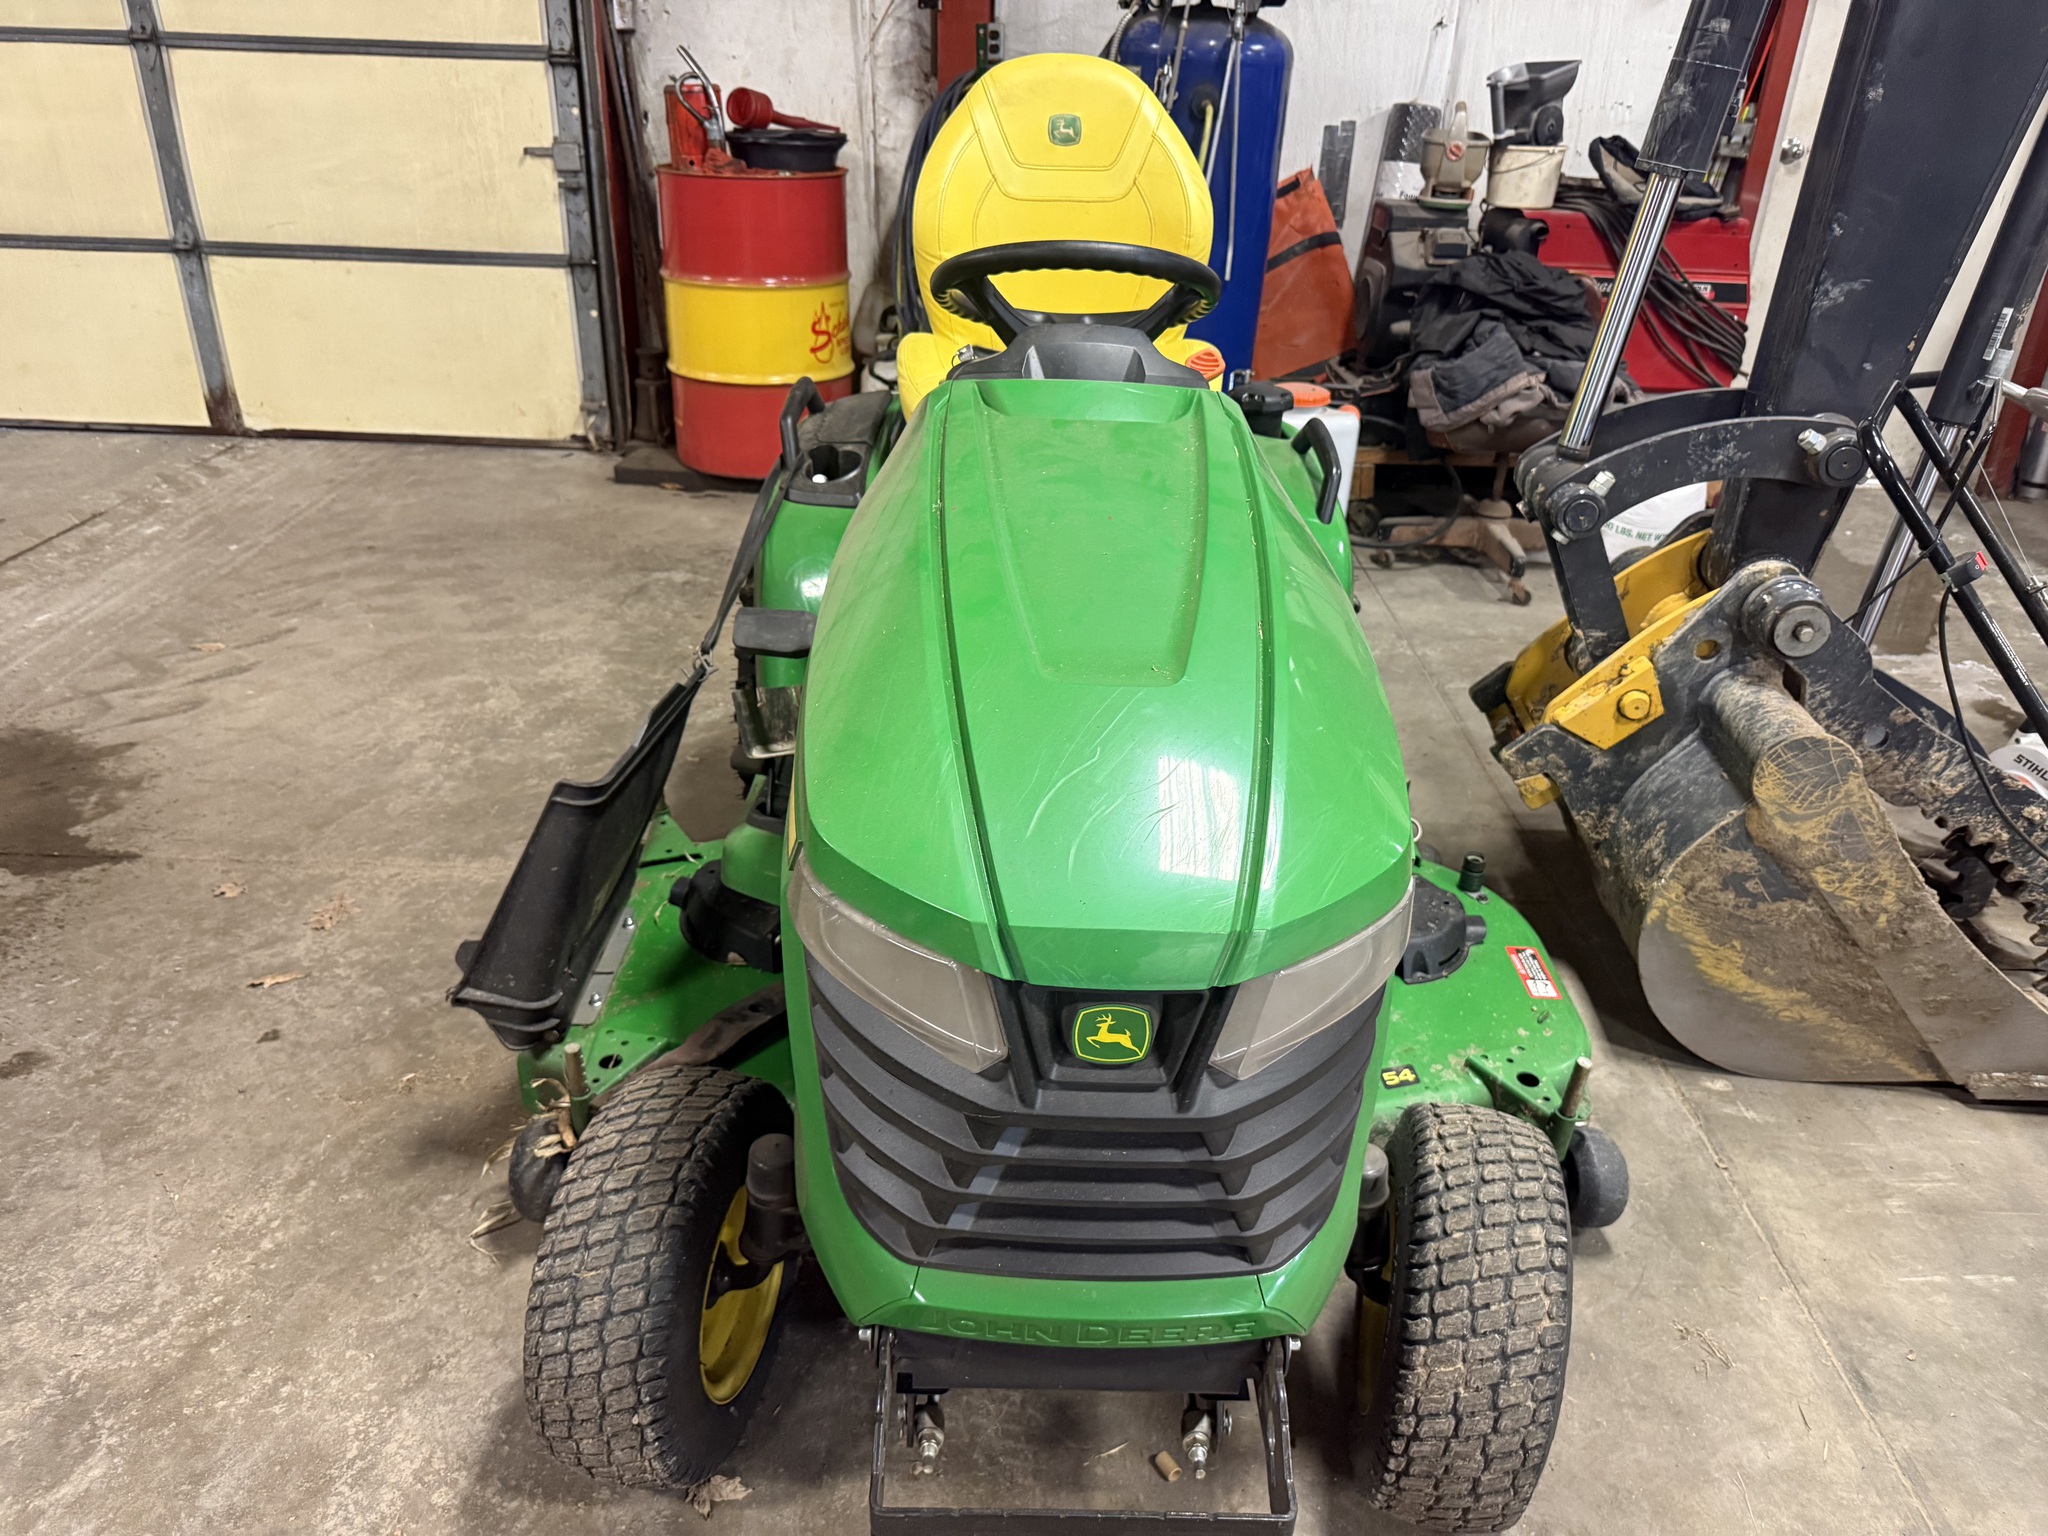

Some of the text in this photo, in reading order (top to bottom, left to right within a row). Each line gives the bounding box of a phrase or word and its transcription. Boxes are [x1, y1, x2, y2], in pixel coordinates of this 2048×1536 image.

[1615, 525, 1633, 537] LBS.
[1635, 531, 1654, 541] NET
[2013, 753, 2048, 781] STIHL
[1382, 1068, 1416, 1086] 54
[917, 1311, 1257, 1344] JOHN DEERE
